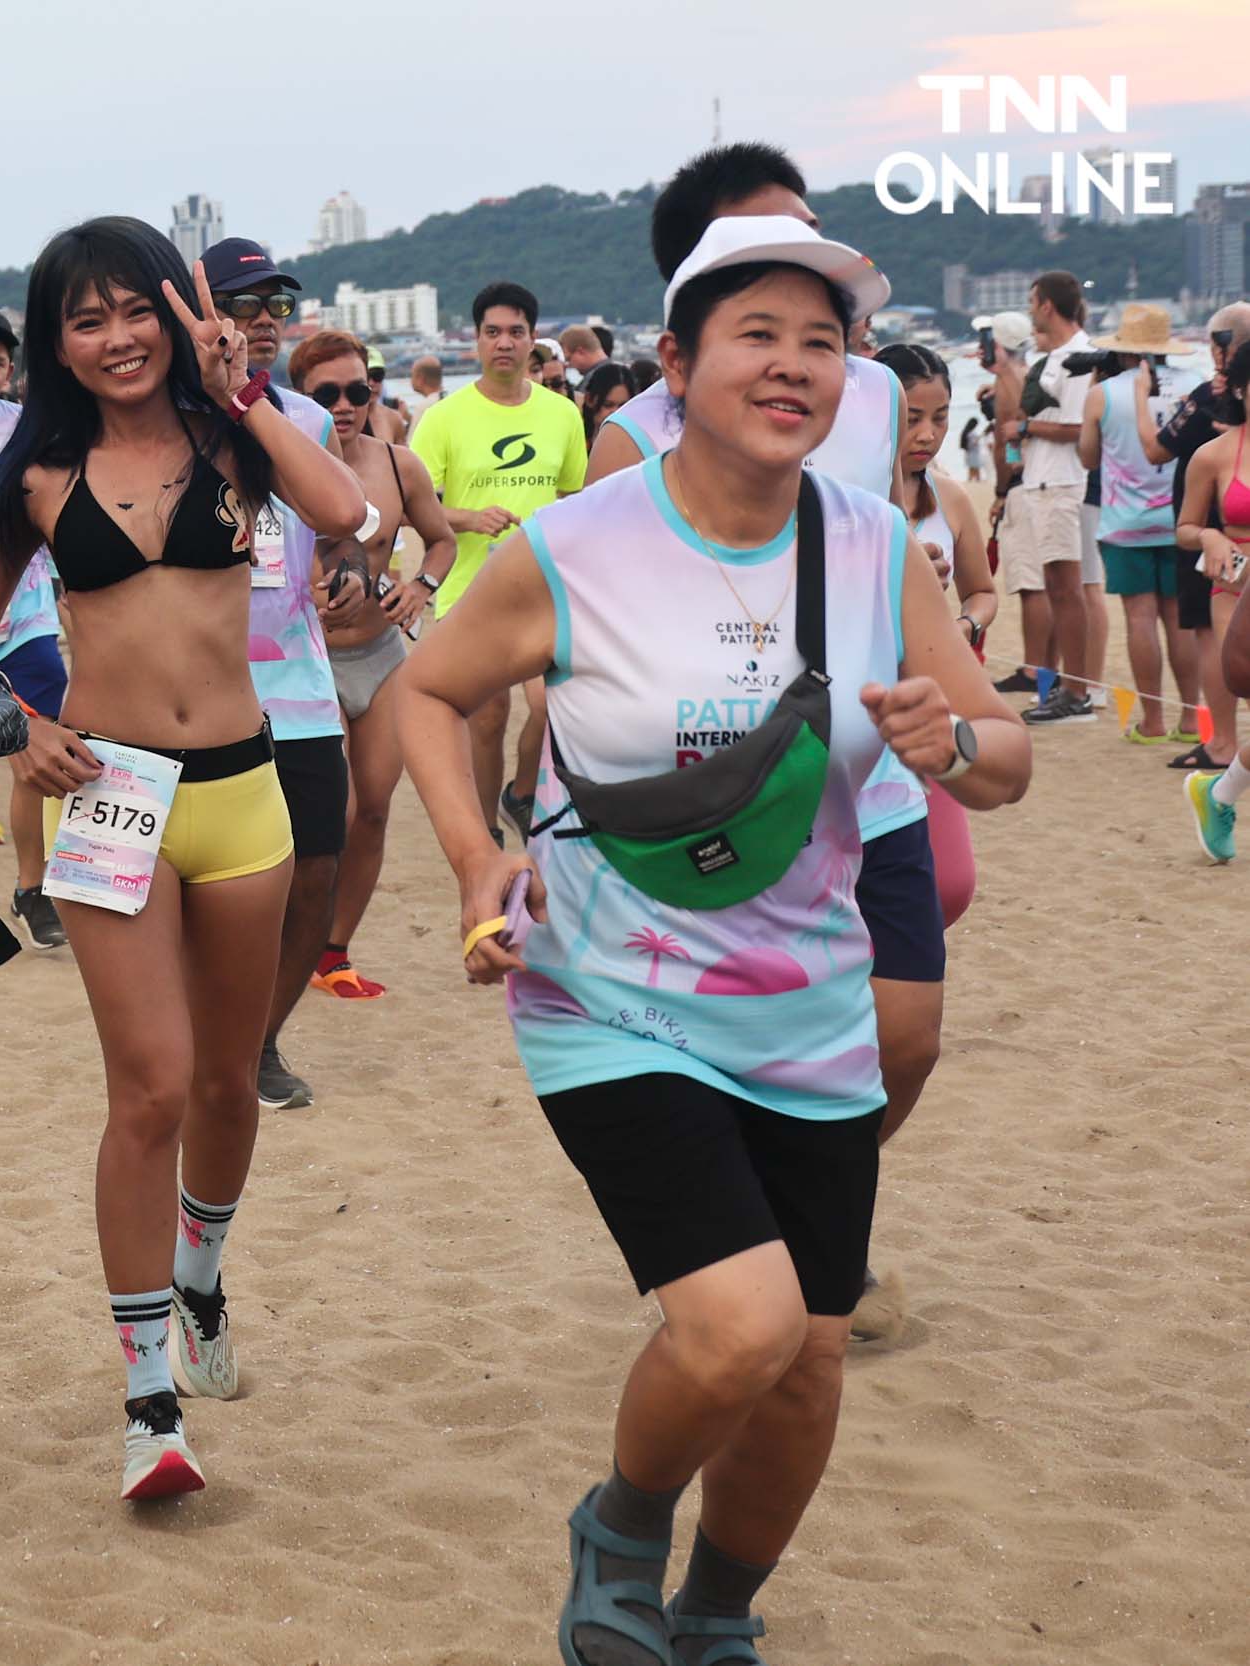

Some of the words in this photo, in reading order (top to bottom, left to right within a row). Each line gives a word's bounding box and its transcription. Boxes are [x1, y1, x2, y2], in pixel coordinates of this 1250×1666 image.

[469, 475, 558, 488] SUPERSPORTS
[716, 622, 780, 633] CENTAL
[720, 634, 777, 644] PATTAYA
[67, 796, 83, 819] F
[92, 800, 156, 836] 5179
[114, 878, 137, 891] 5KM
